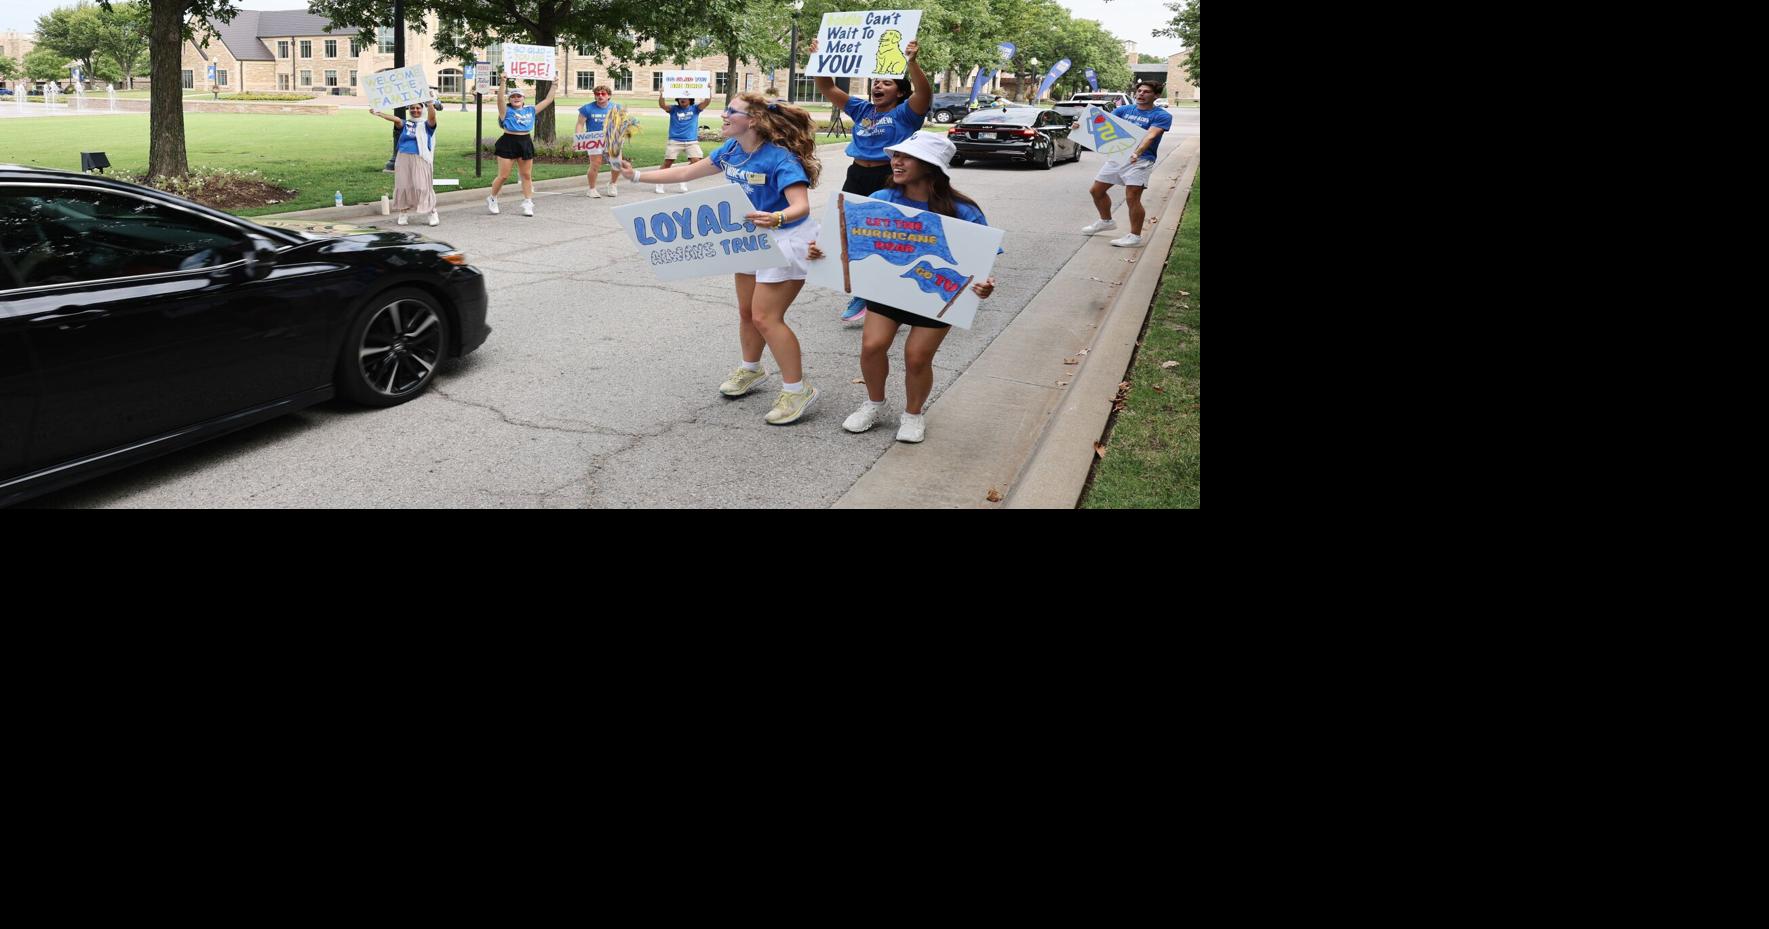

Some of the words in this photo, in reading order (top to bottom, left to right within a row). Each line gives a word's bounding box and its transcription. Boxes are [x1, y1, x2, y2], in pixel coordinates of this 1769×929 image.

[865, 12, 901, 25] Can't
[827, 26, 859, 40] Wait
[862, 26, 874, 39] To
[826, 40, 862, 53] Meet
[511, 61, 550, 76] HERE!
[817, 54, 863, 74] YOU!
[576, 132, 604, 141] Welco
[633, 201, 757, 246] LOYAL,
[865, 217, 891, 227] LET
[893, 219, 923, 231] THE
[851, 228, 937, 245] HURRICANE
[650, 241, 717, 266] ALWAYS
[720, 233, 772, 255] TRUE
[873, 240, 917, 253] ROAR
[915, 267, 932, 280] GO
[935, 274, 959, 292] TU
